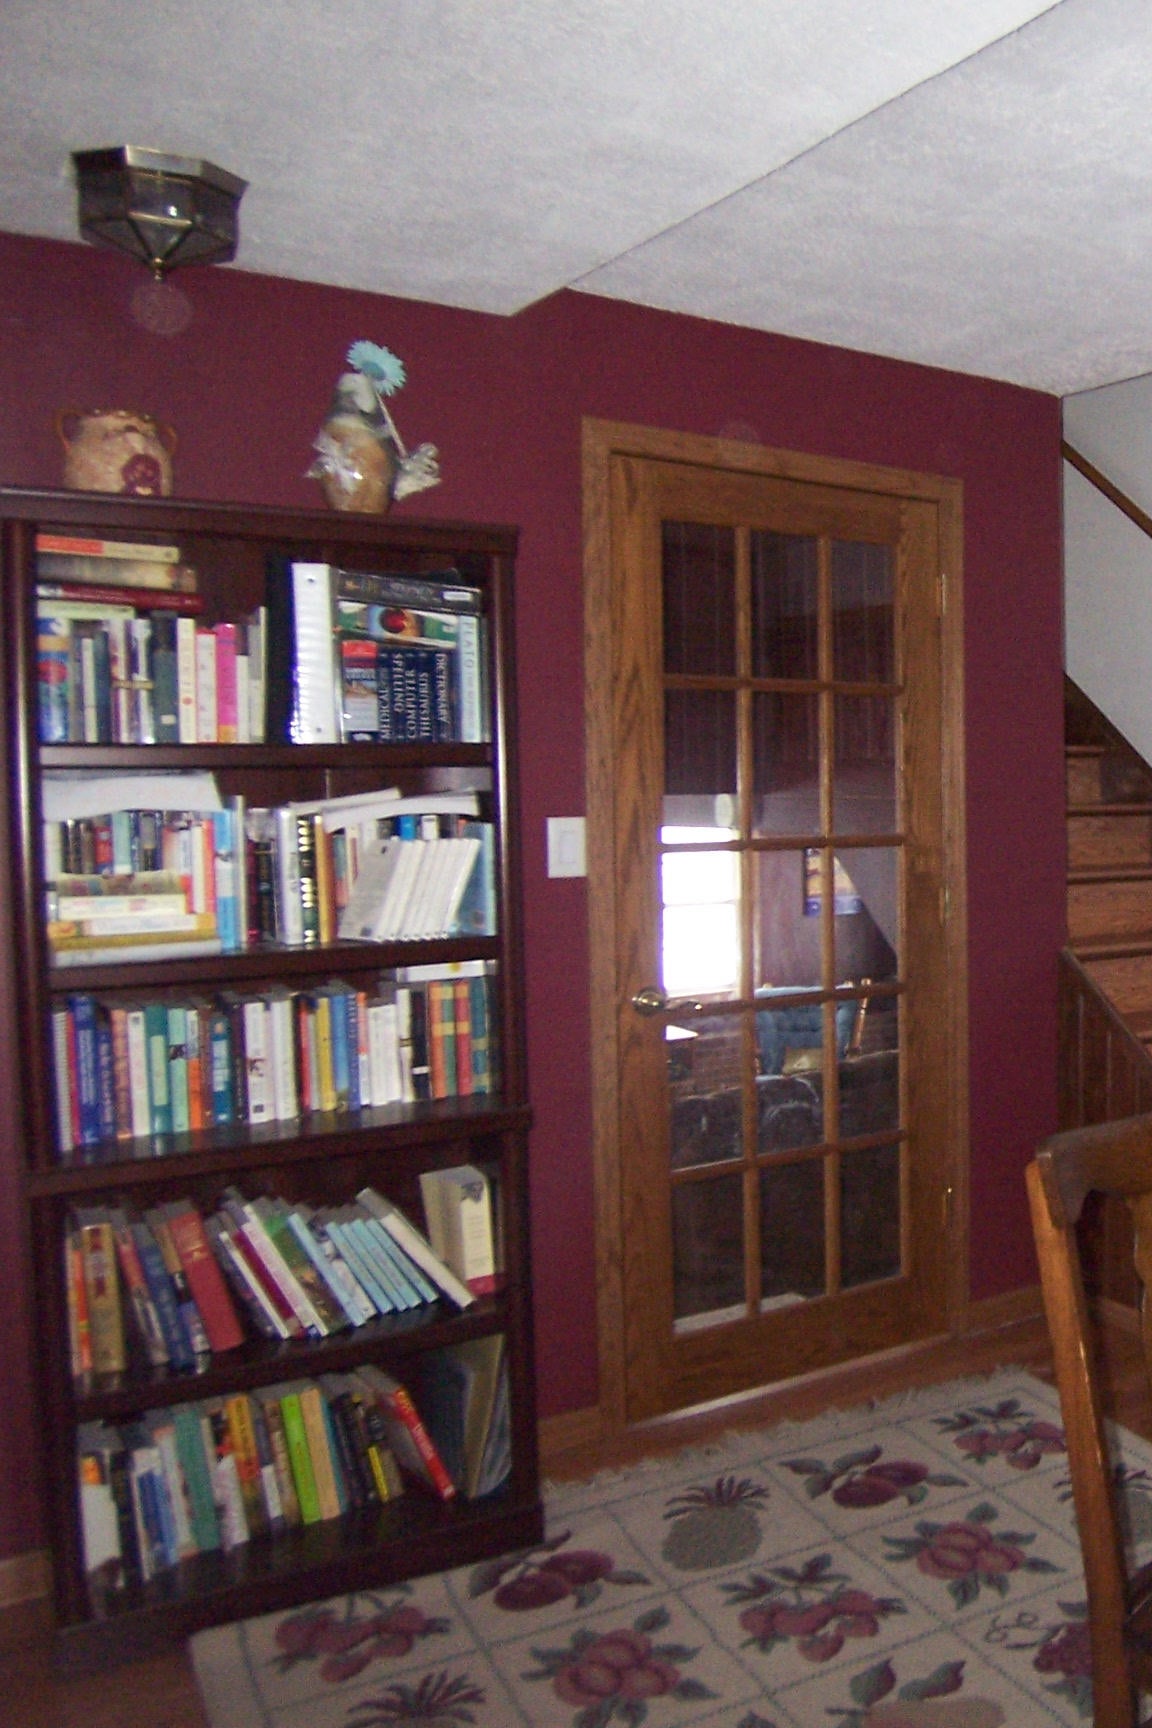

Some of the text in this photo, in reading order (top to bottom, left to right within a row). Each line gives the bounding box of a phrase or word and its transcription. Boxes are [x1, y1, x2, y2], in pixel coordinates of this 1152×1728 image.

[463, 621, 477, 669] PLATO
[393, 653, 404, 712] SPELLING
[405, 669, 417, 739] COMPUTER
[419, 672, 431, 736] THESAURUS
[435, 653, 450, 724] DICTIONARY
[378, 689, 391, 739] MEDICAL
